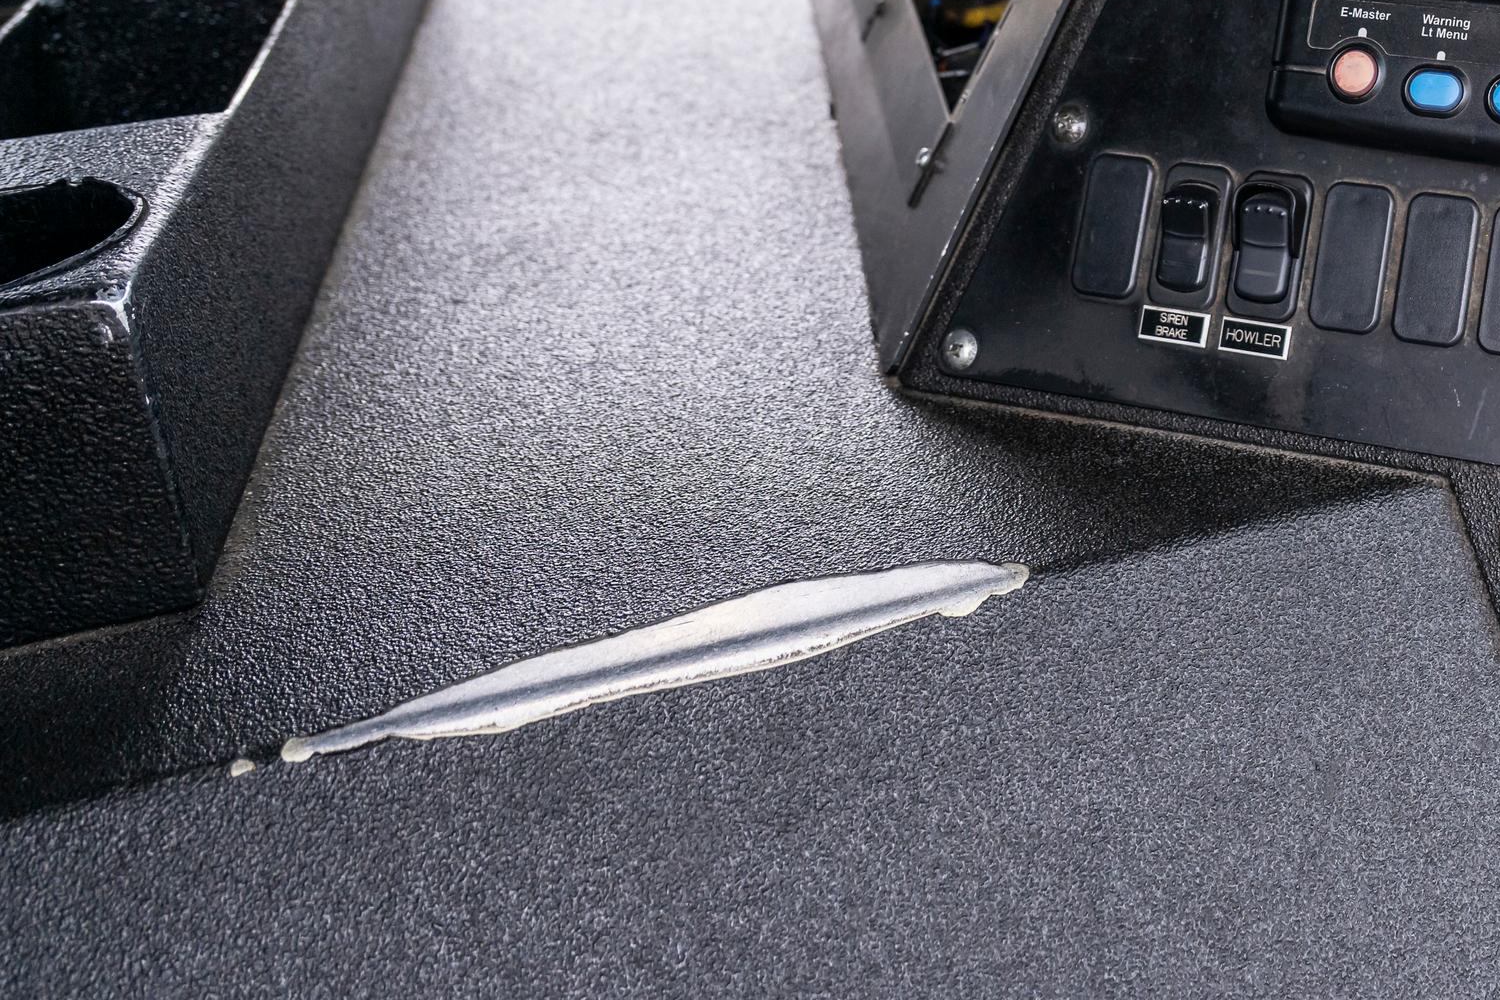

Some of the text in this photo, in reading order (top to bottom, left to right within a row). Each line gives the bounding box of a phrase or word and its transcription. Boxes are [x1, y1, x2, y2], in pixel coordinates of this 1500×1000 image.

[1340, 6, 1391, 21] E-Master
[1422, 13, 1471, 31] Warning
[1421, 26, 1468, 41] Lt Menu
[1159, 312, 1189, 326] SIREN
[1154, 325, 1189, 340] BRAKE
[1226, 328, 1282, 348] HOWLER
